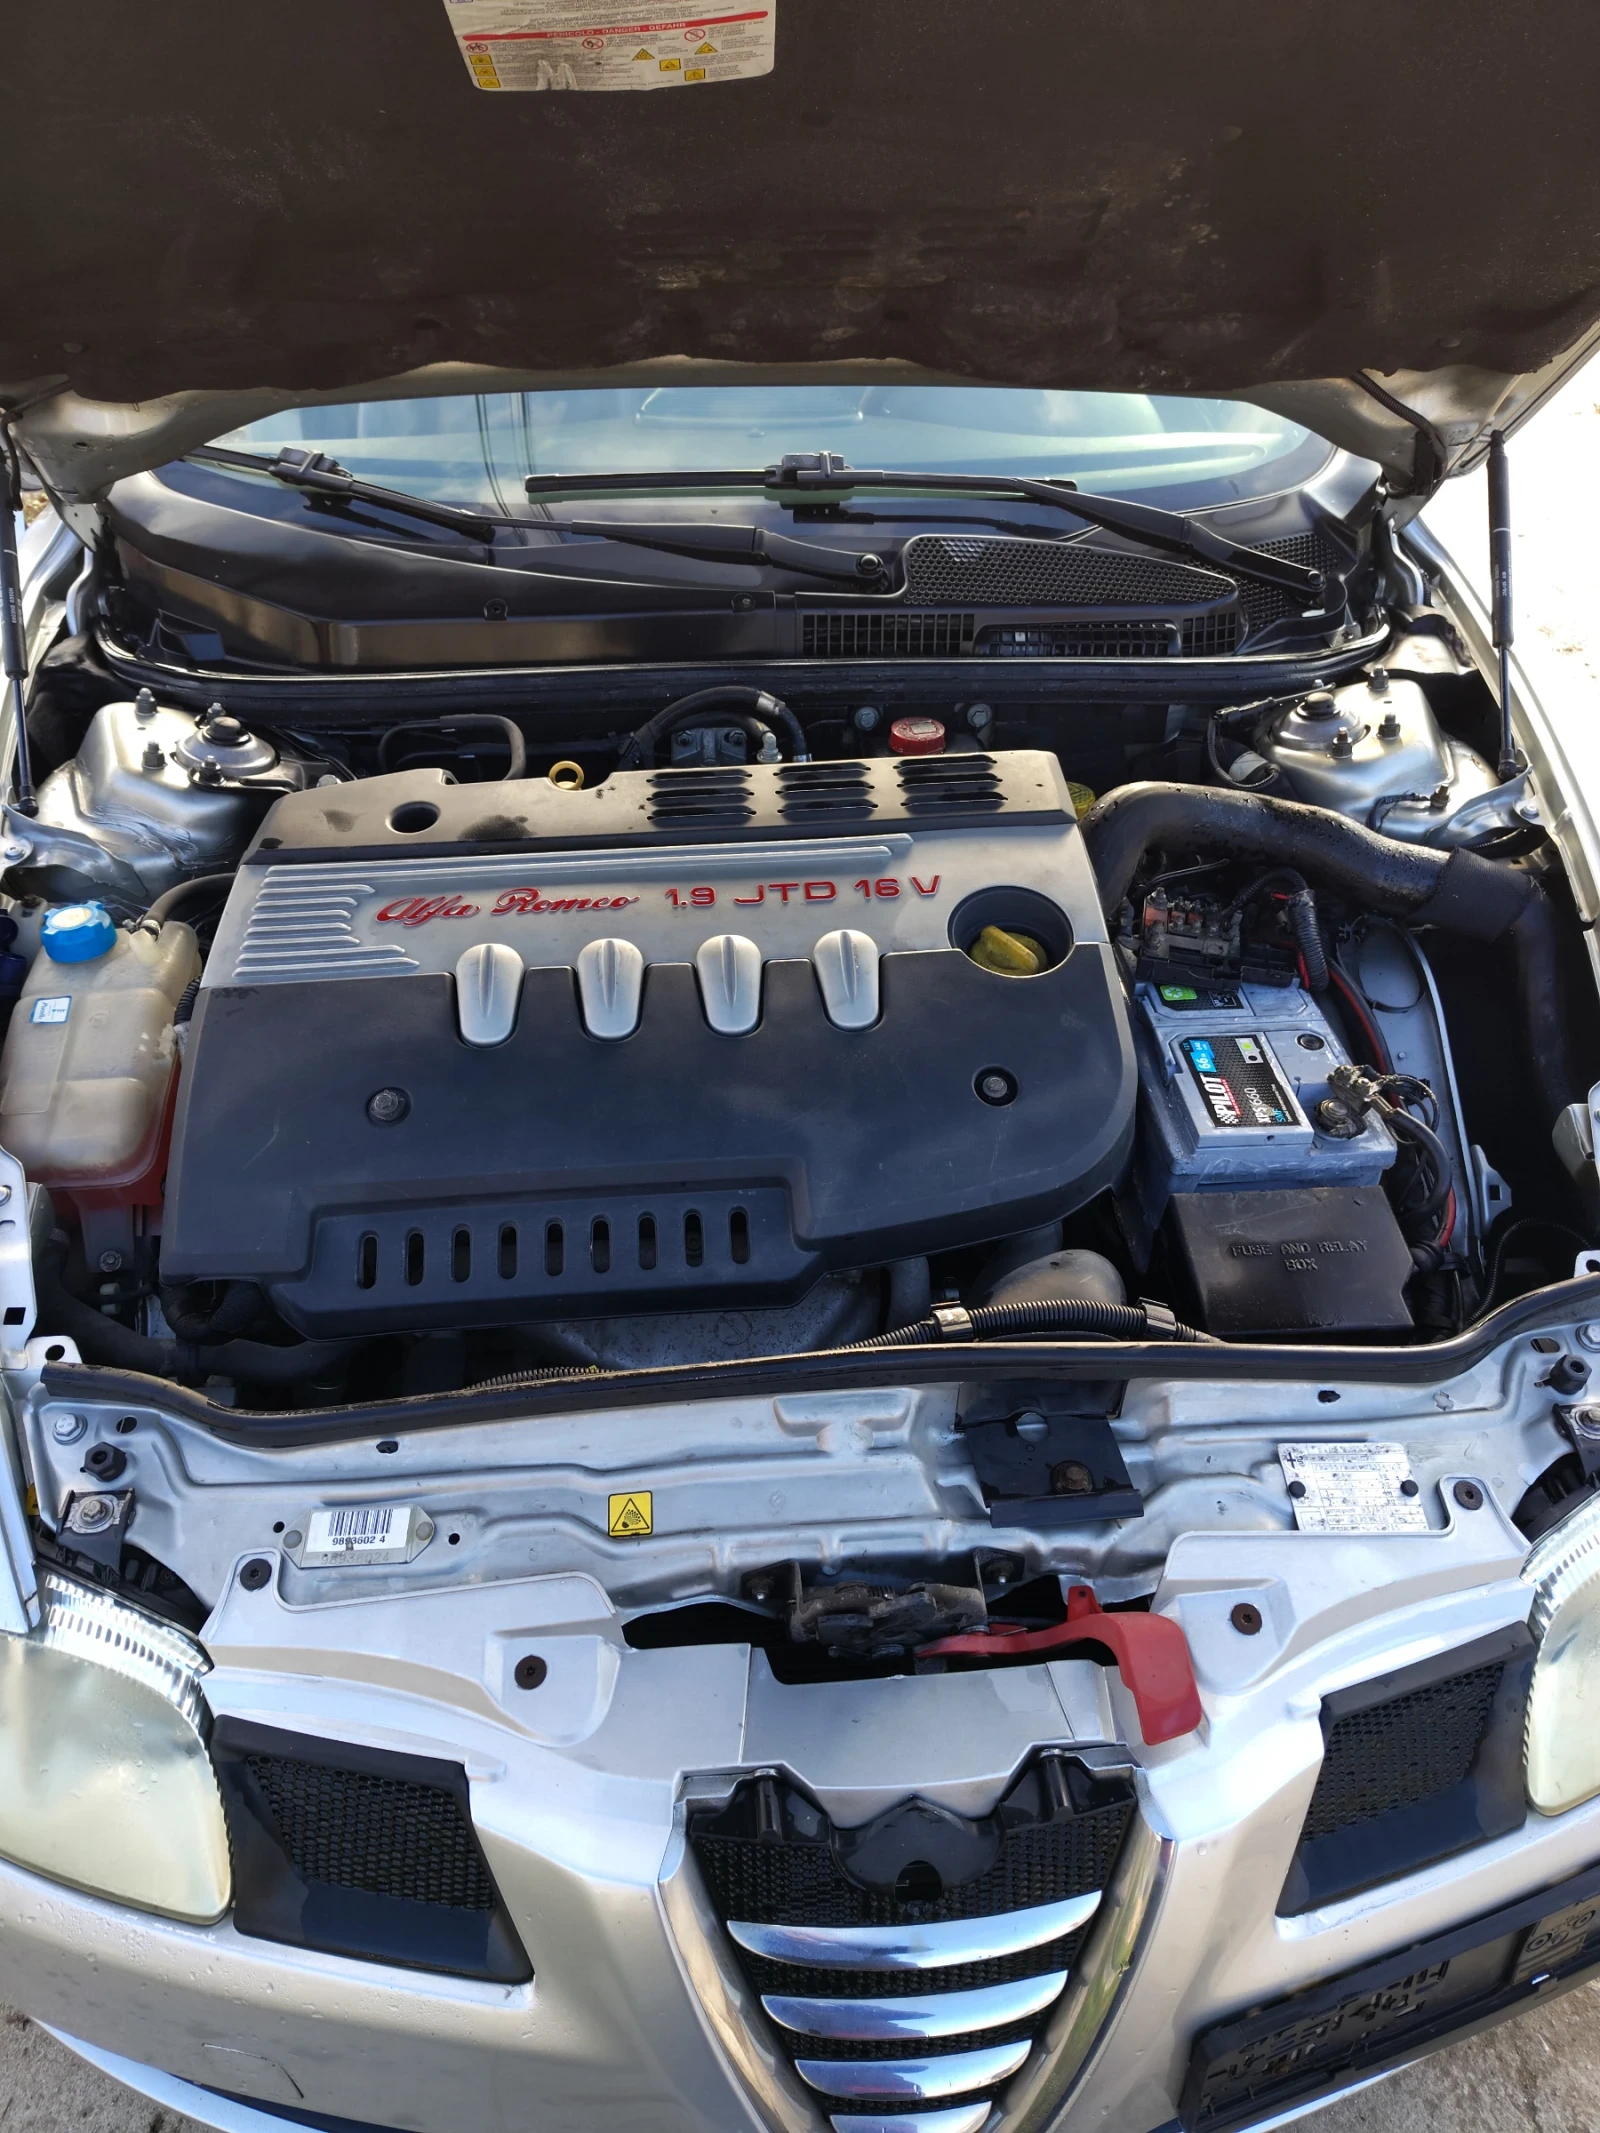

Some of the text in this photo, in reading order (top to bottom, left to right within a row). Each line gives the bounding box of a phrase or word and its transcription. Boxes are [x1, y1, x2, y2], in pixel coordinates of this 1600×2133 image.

[547, 30, 594, 38] PERICOLO
[602, 26, 641, 35] DANGER
[649, 22, 686, 31] GEFAHR
[665, 886, 717, 907] 1.9
[733, 880, 837, 904] JTD
[376, 887, 640, 927] Alfa Romeo
[1196, 1056, 1212, 1069] 66
[1200, 1073, 1236, 1117] PILOT
[1244, 1087, 1272, 1123] XPS 660
[1231, 1239, 1368, 1257] FUSE AND RELAY
[1283, 1257, 1319, 1271] BOX
